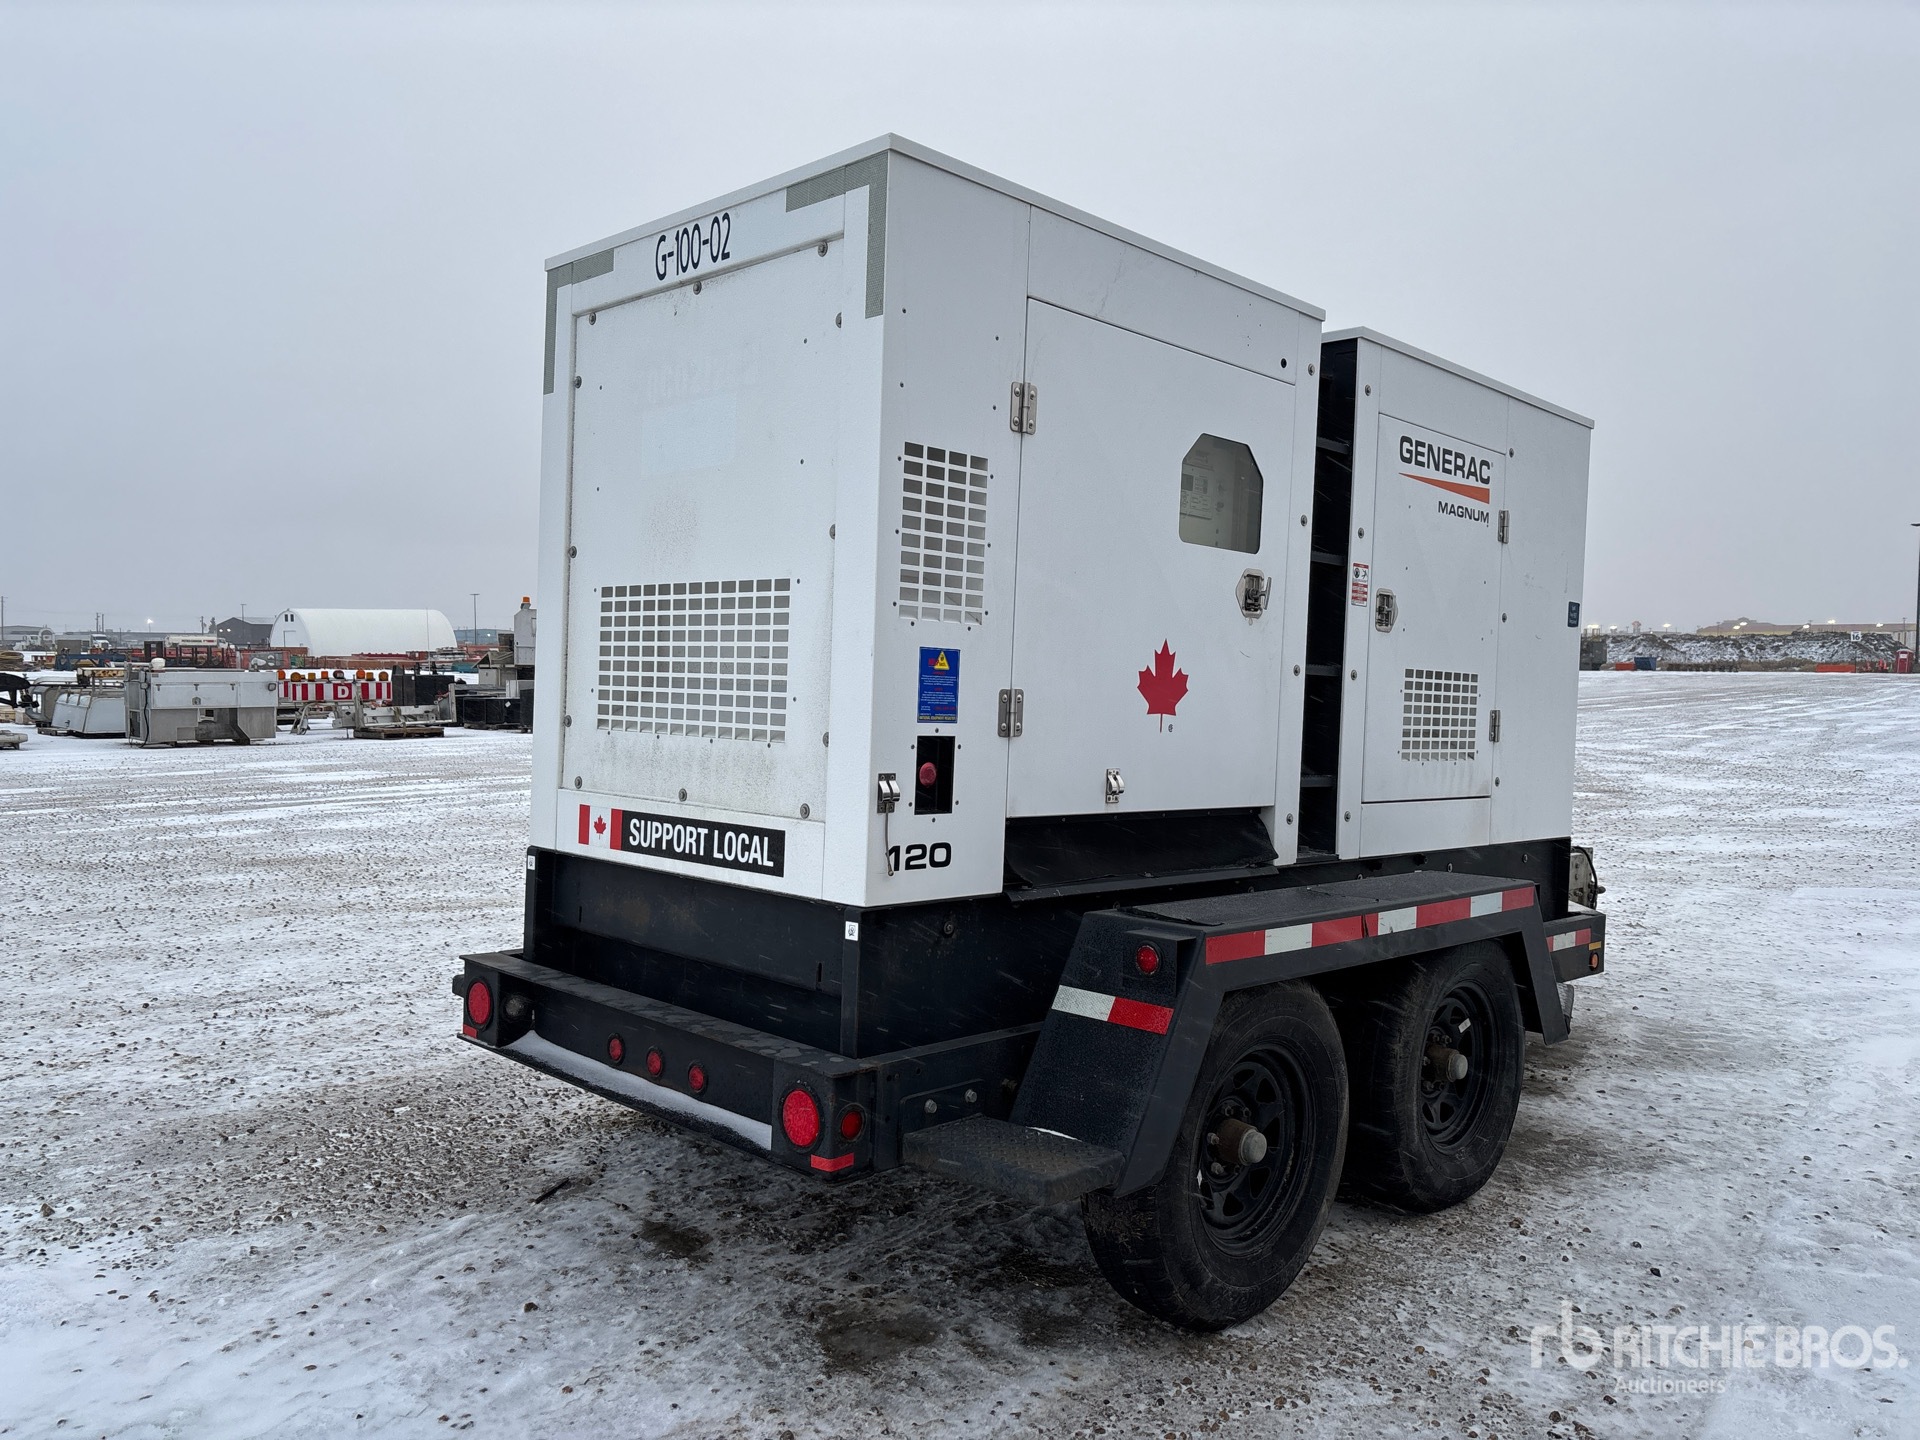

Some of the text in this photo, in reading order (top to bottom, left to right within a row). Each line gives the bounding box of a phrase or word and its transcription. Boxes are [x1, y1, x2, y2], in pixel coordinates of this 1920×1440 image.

[655, 212, 731, 281] G-100-02
[1399, 435, 1491, 485] GENERAC
[1437, 500, 1490, 524] MAGNUM
[337, 685, 350, 699] D
[629, 818, 774, 867] SUPPORT LOCAL
[888, 841, 952, 872] 120
